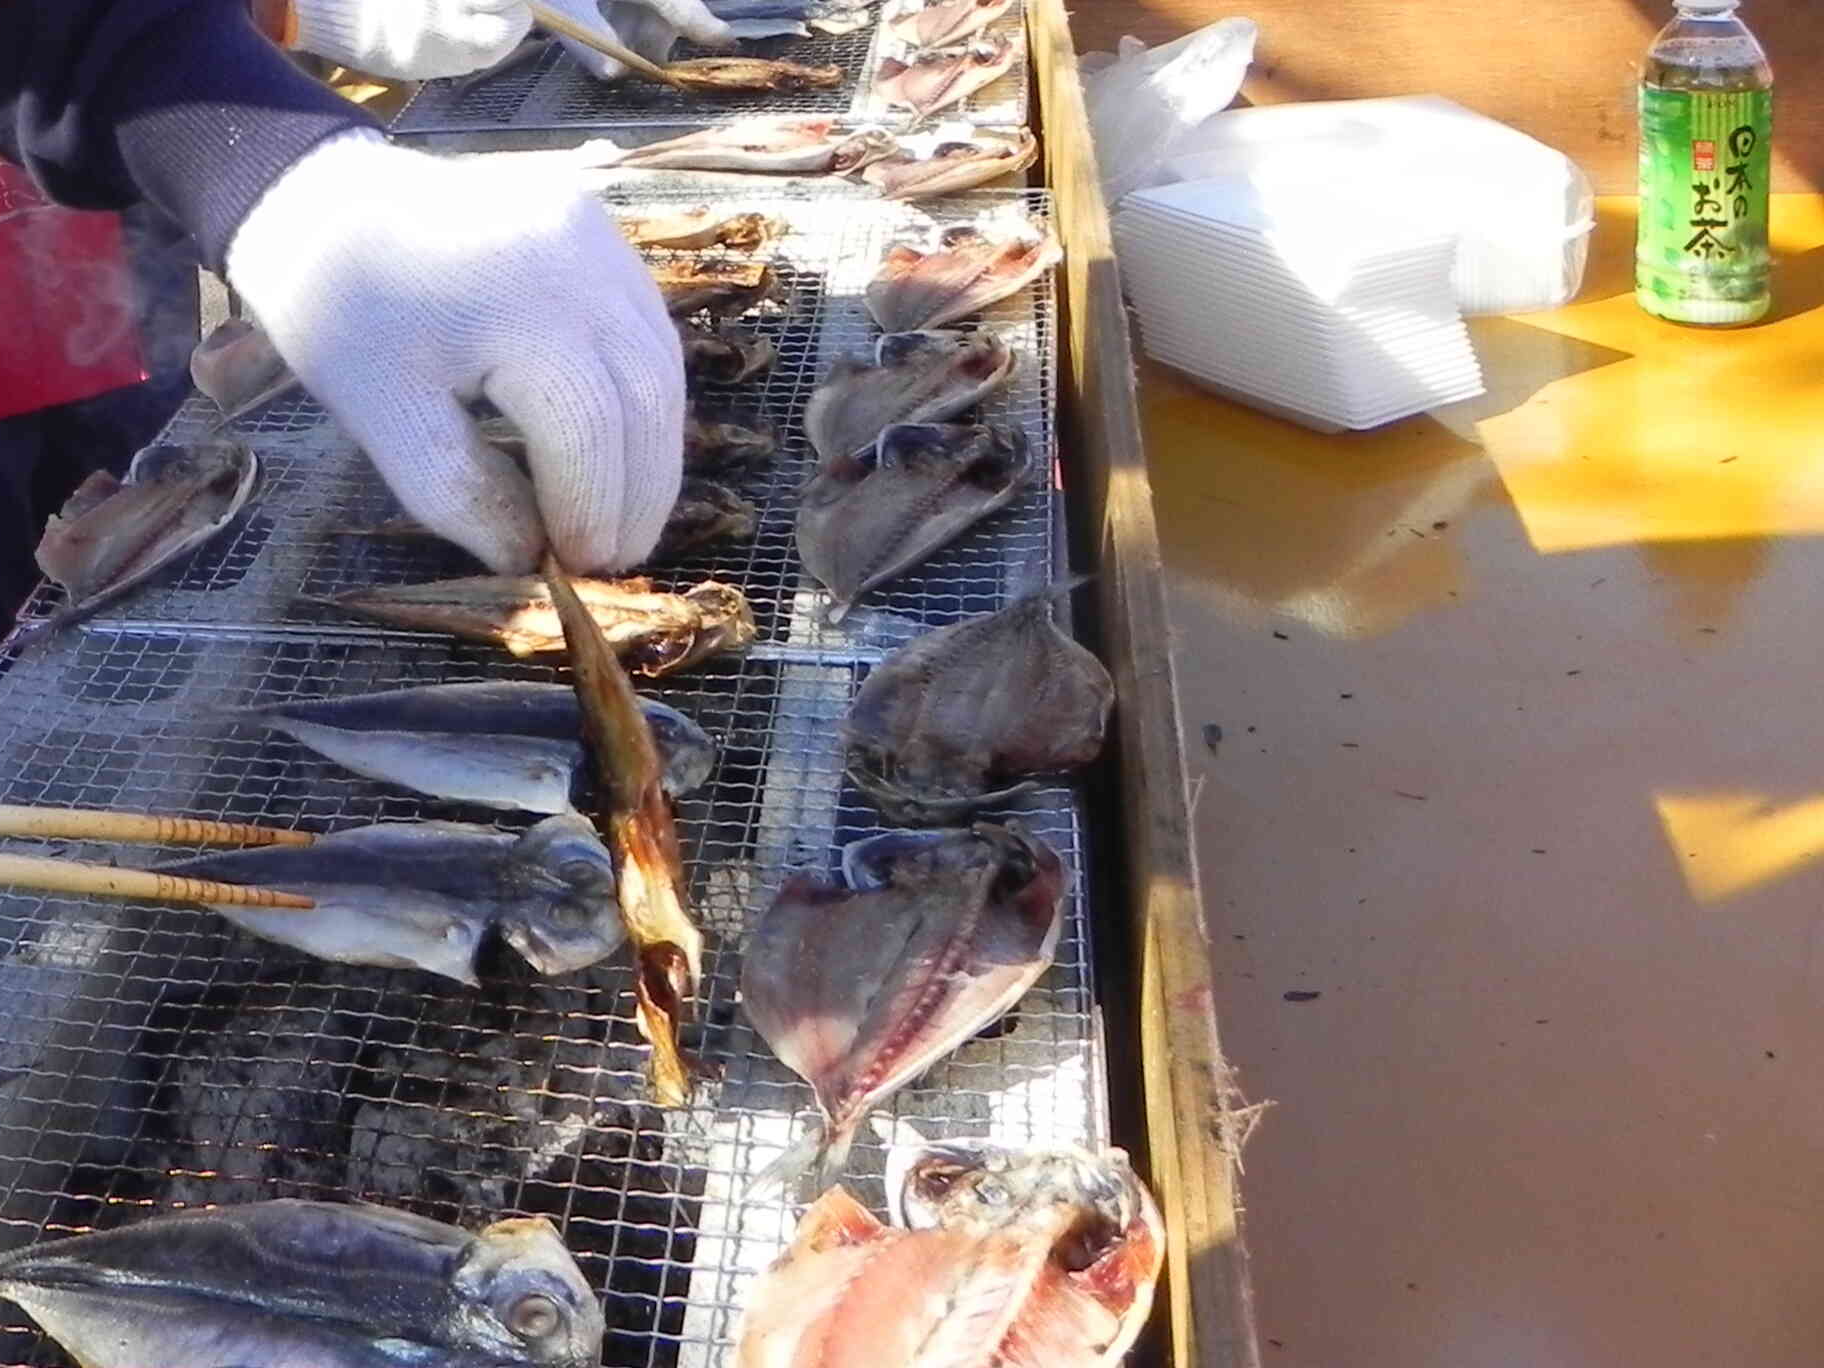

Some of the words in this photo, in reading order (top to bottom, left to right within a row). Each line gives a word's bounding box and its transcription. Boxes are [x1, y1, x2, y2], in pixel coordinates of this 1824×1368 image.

[1725, 125, 1757, 219] 日本の
[1683, 176, 1737, 260] お茶
